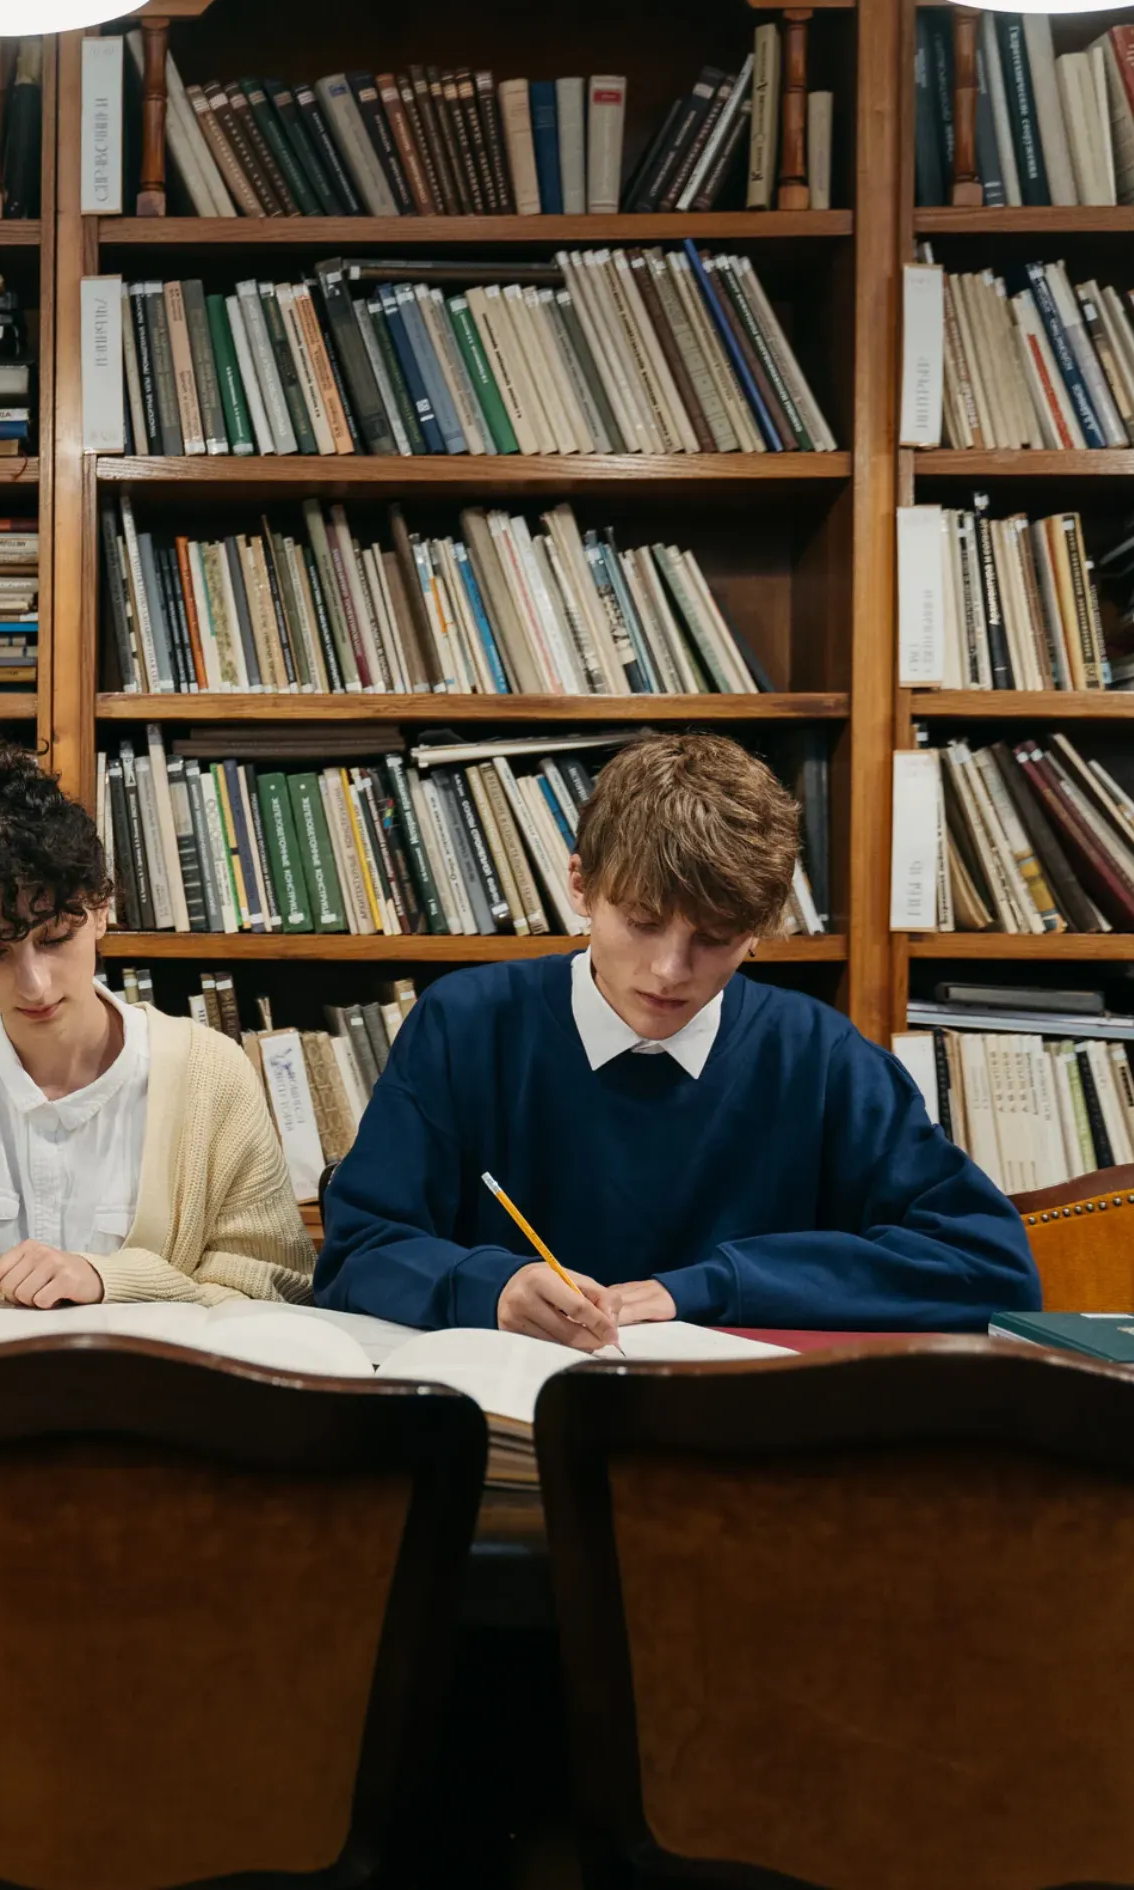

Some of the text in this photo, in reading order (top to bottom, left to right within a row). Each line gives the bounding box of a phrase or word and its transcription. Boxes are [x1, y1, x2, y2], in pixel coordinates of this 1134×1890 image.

[271, 797, 298, 914] ЖЕЛЕЗОБЕТОННЫЕ КОНСТРУКЦ
[301, 797, 329, 915] ЖЕЛЕЗОБЕТОННЫЕ КОНСТРУКЦ
